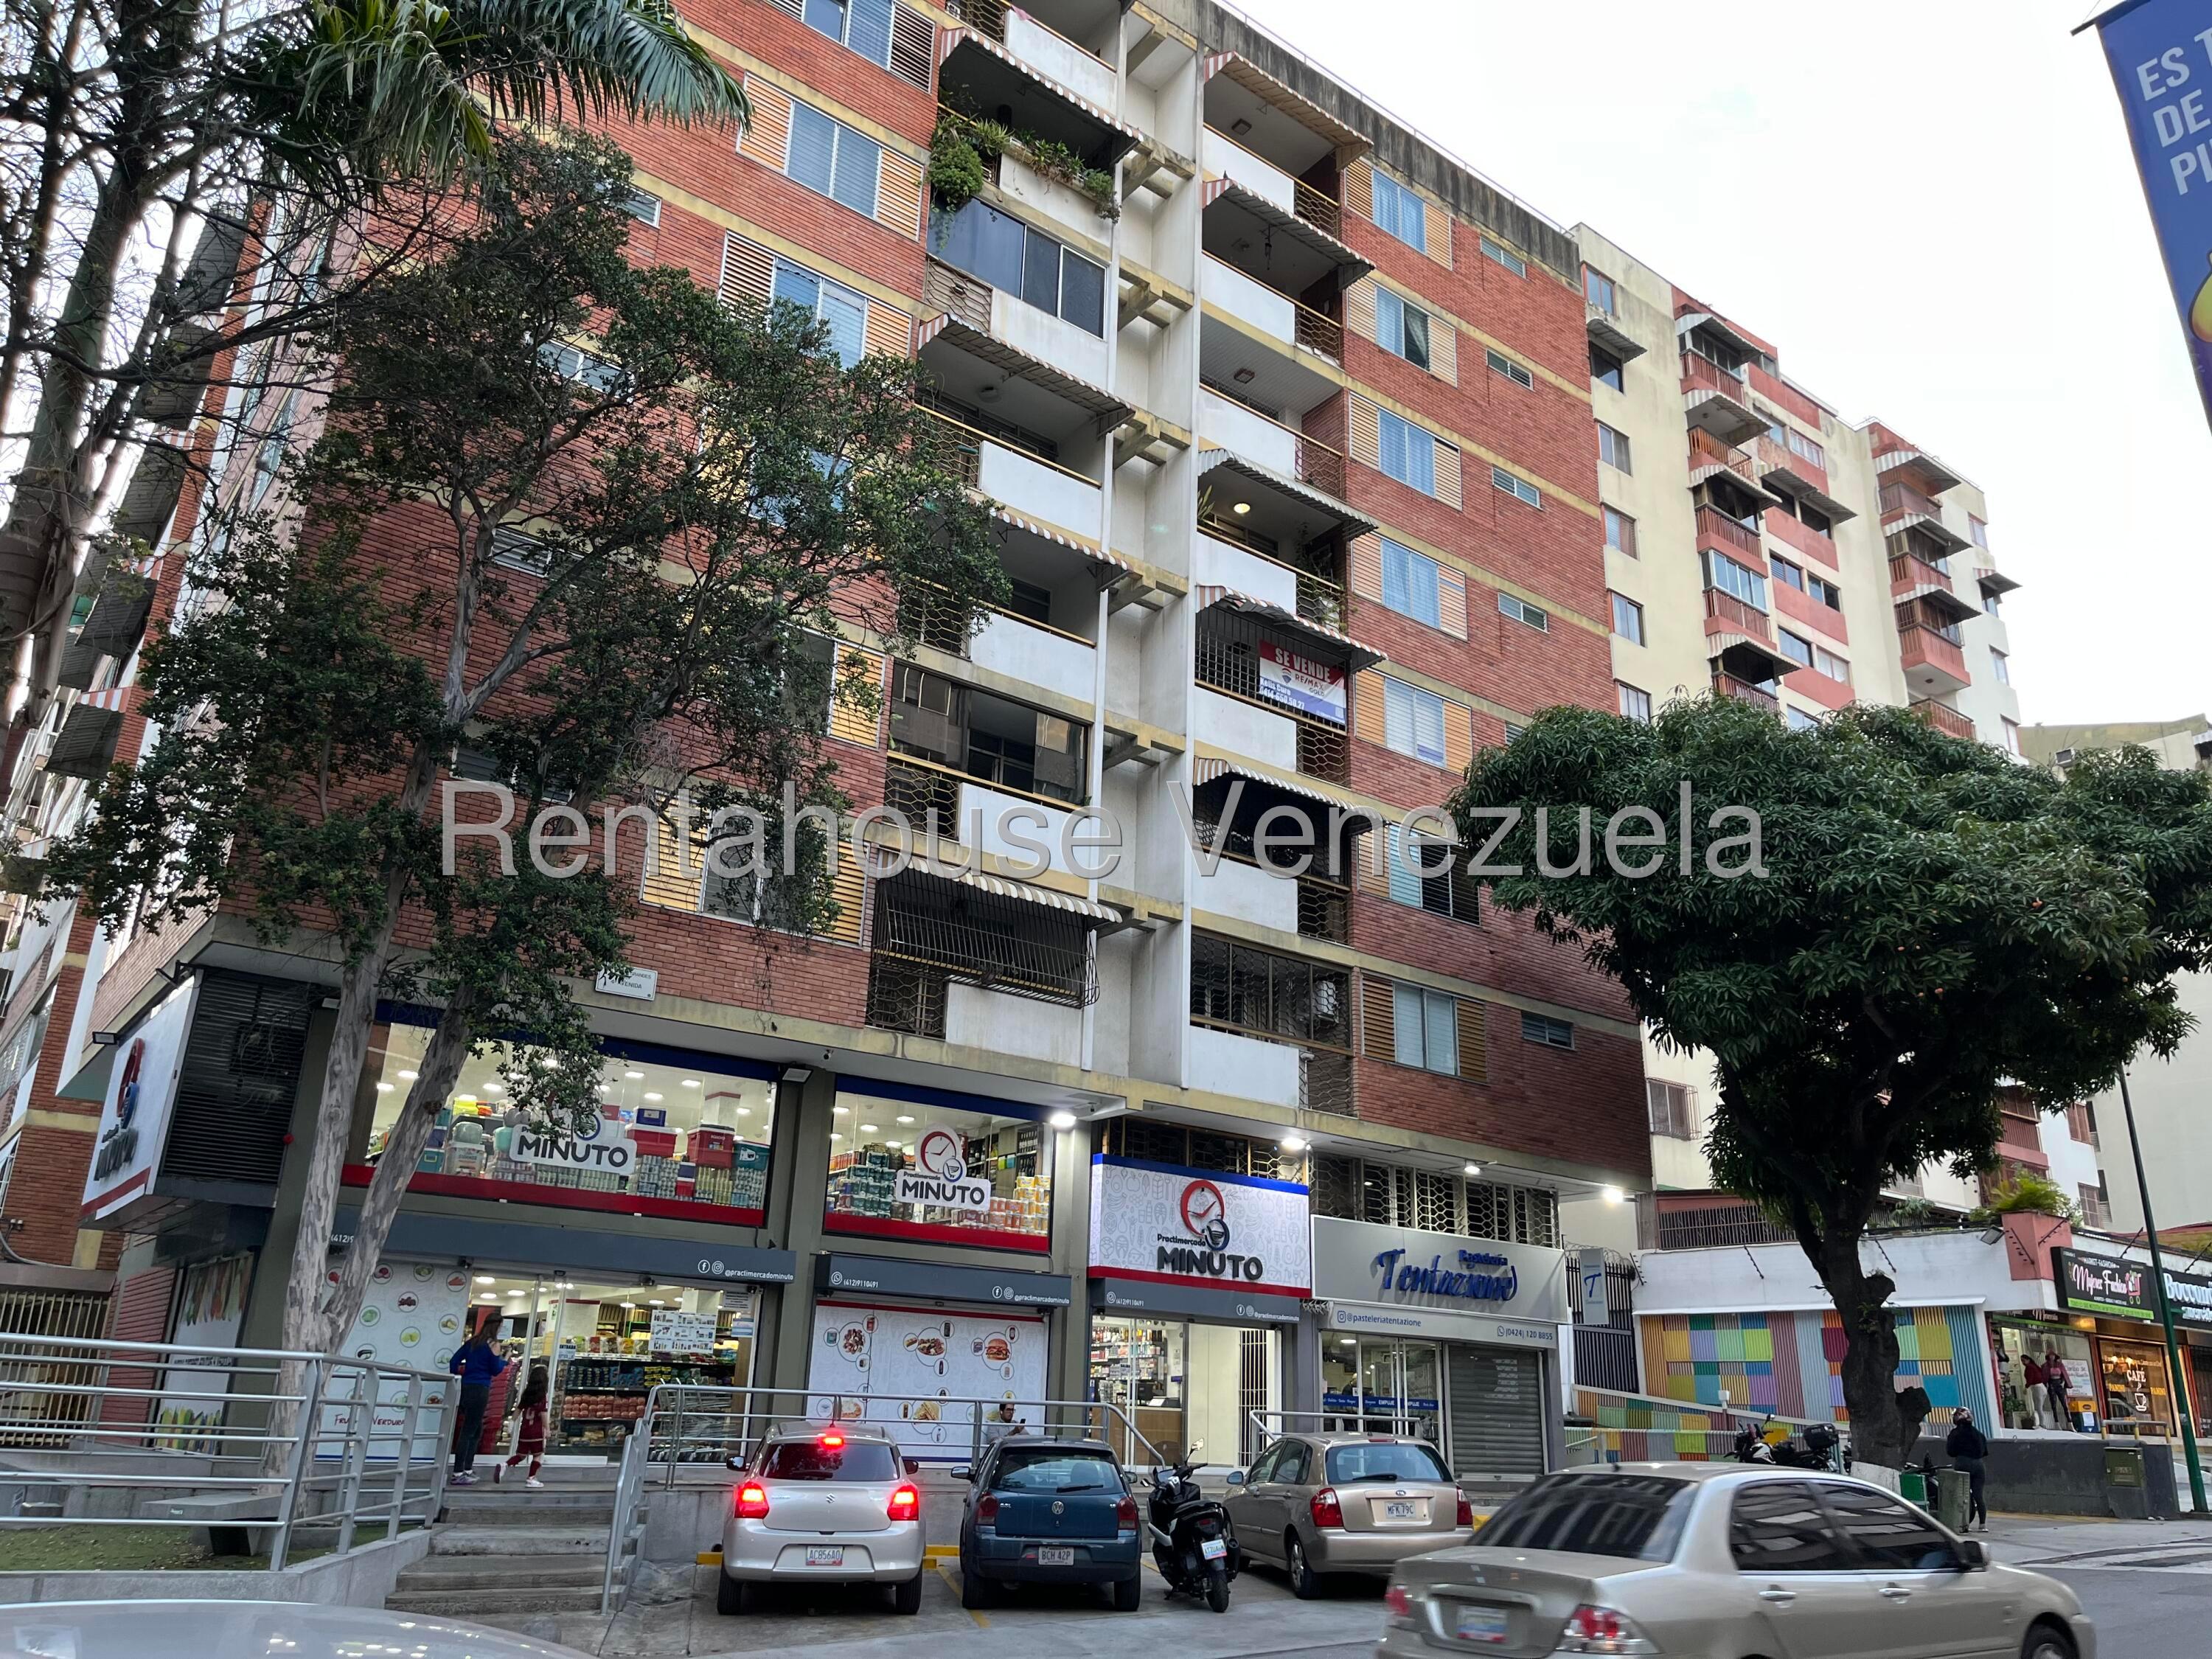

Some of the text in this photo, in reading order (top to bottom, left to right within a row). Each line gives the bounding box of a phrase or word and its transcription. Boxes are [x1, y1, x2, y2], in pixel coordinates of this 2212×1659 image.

[2137, 47, 2190, 101] ES
[2153, 88, 2211, 147] DE
[2170, 138, 2212, 195] PI
[1275, 647, 1331, 683] SE VENDE
[1295, 672, 1324, 691] RE/MAX
[619, 979, 642, 990] VENIDA
[518, 1135, 628, 1167] MINUTO
[902, 1179, 985, 1205] MINUTO
[1157, 1233, 1206, 1247] Practimercado
[1156, 1246, 1263, 1281] MINUTO
[724, 1269, 794, 1281] @practimercadominuto
[843, 1279, 879, 1289] (412)9110491
[1347, 1312, 1422, 1327] @pasteleriatentazione
[1526, 1330, 1537, 1338] 120
[1538, 1332, 1553, 1340] 8855
[2126, 1367, 2146, 1382] CAFÉ
[1387, 1505, 1414, 1515] MFK 79C
[1042, 1551, 1071, 1561] BCH 42P
